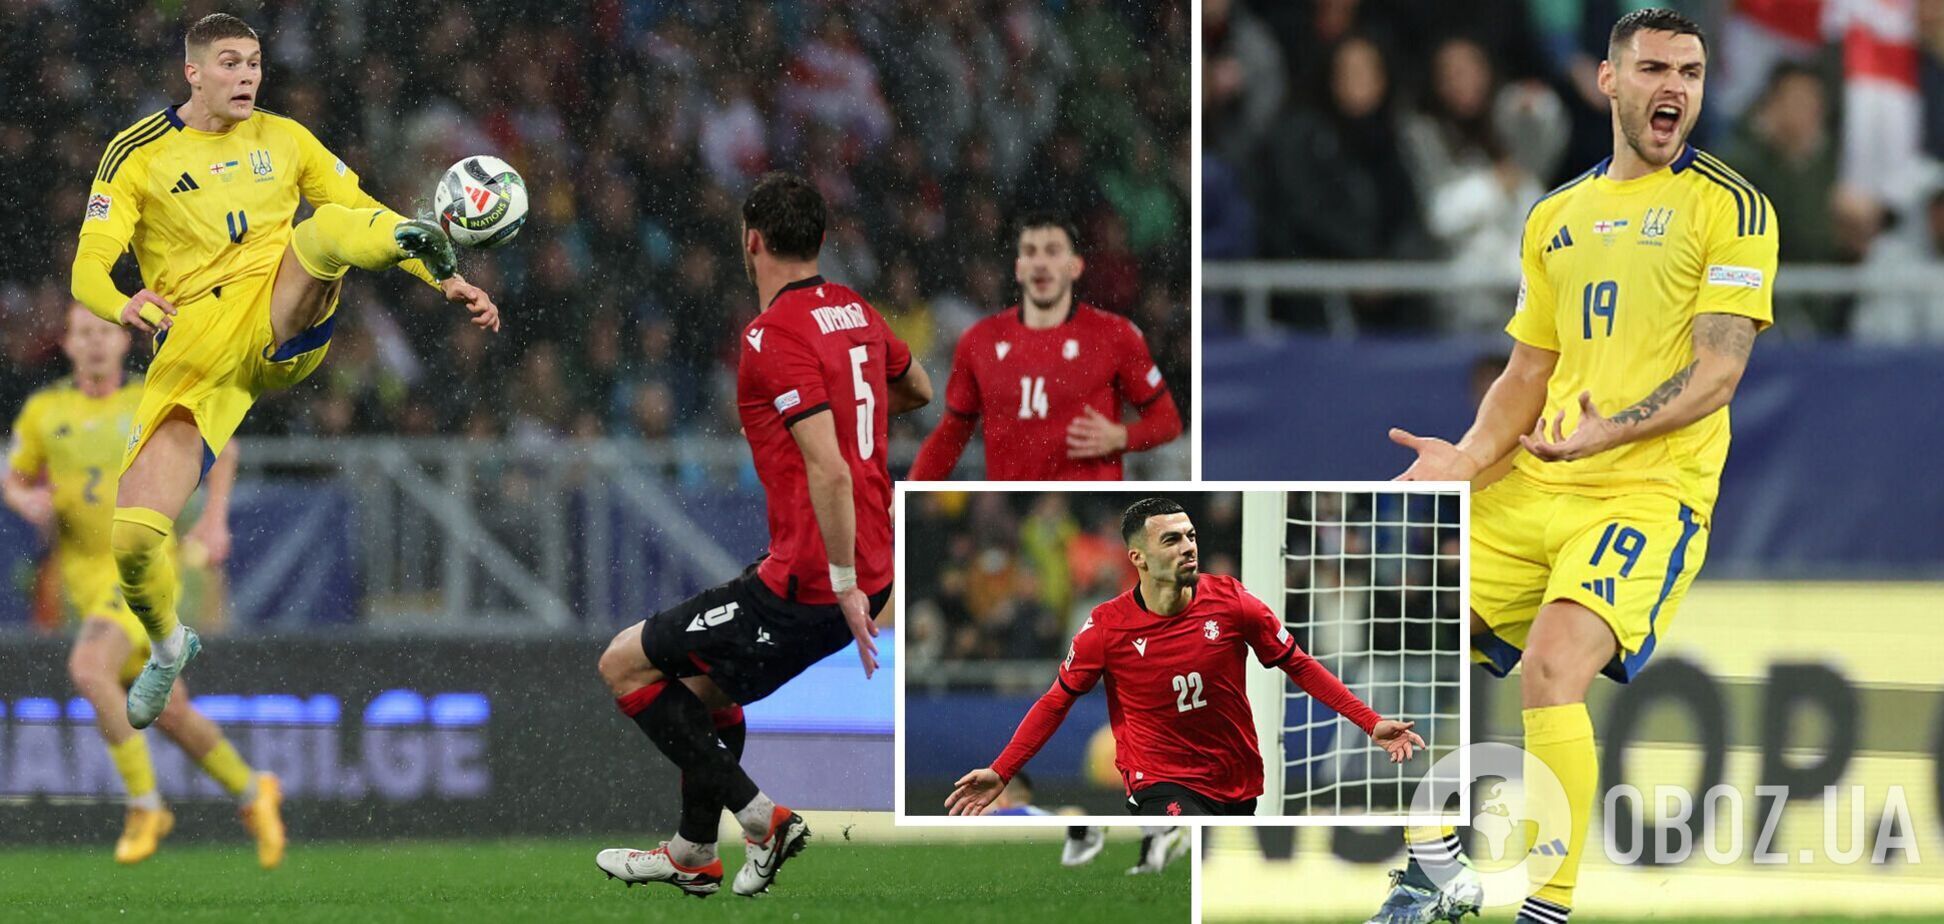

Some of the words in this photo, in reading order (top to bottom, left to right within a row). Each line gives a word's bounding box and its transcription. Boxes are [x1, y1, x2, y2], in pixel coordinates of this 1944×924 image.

[1583, 281, 1617, 339] 19
[849, 345, 875, 461] 5
[1018, 376, 1049, 419] 14
[1588, 522, 1647, 578] 19
[704, 601, 740, 627] 5
[1172, 671, 1207, 713] 22
